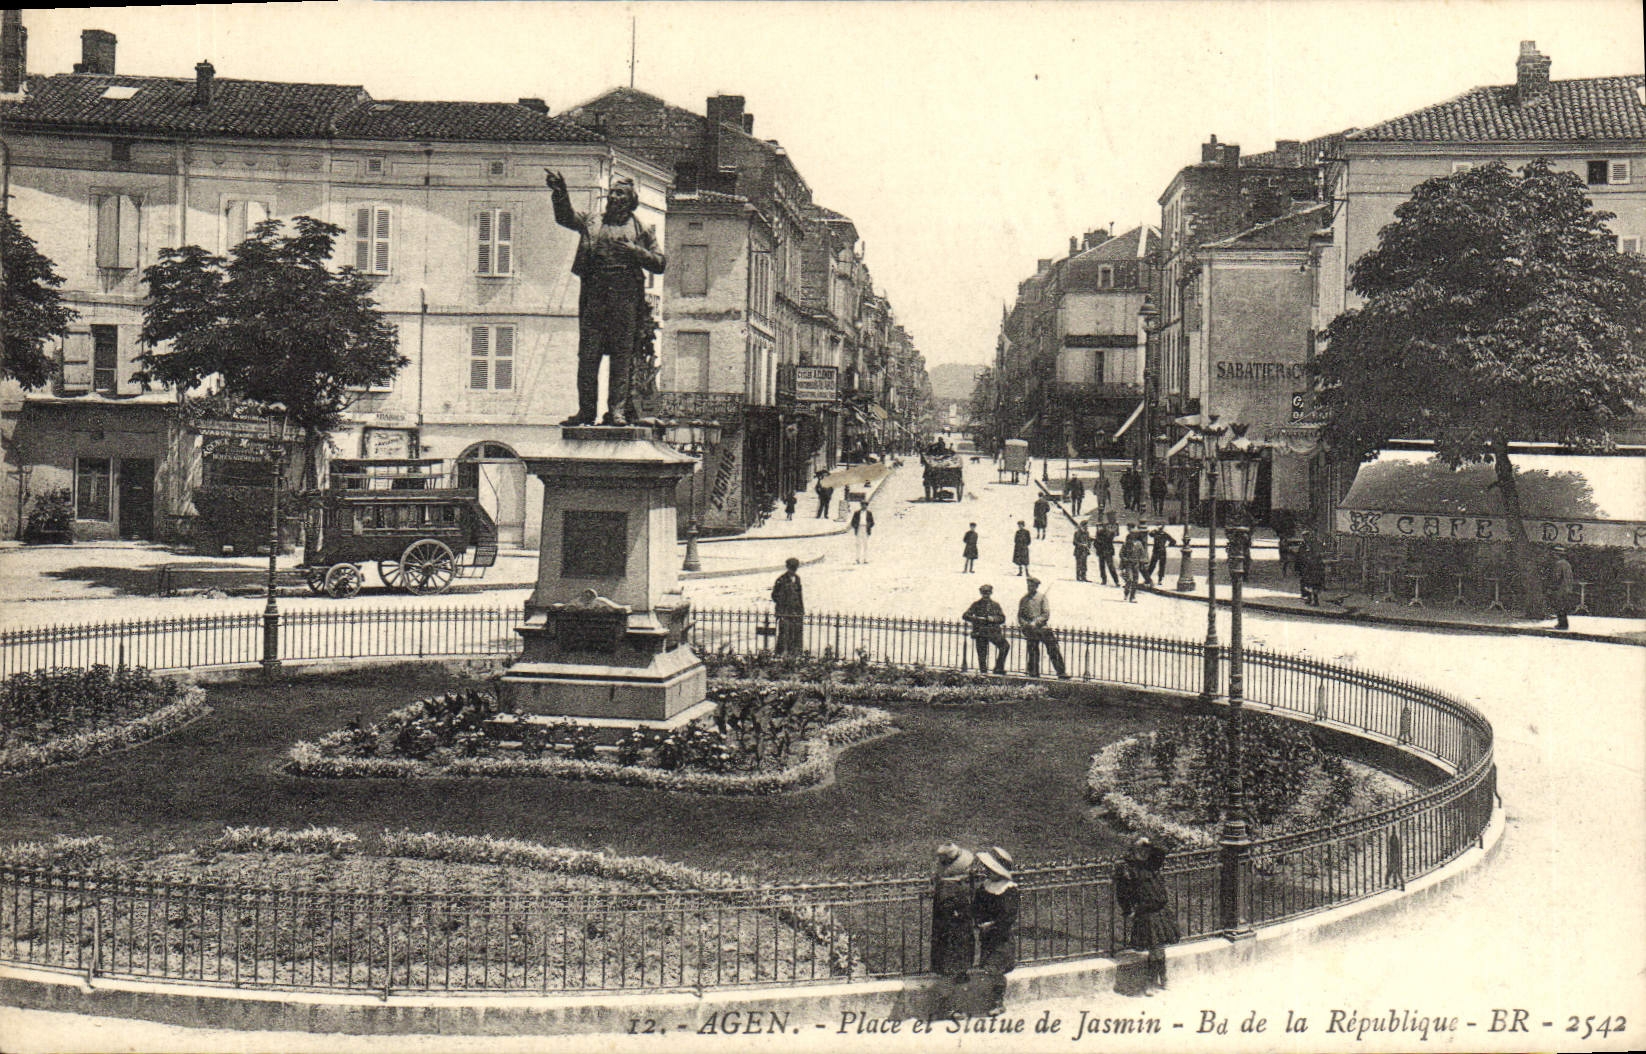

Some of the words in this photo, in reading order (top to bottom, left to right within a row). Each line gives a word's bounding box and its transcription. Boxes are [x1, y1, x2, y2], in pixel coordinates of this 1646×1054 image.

[1216, 361, 1285, 379] SABATIER
[1397, 515, 1493, 539] CAFE
[1541, 521, 1584, 543] DE
